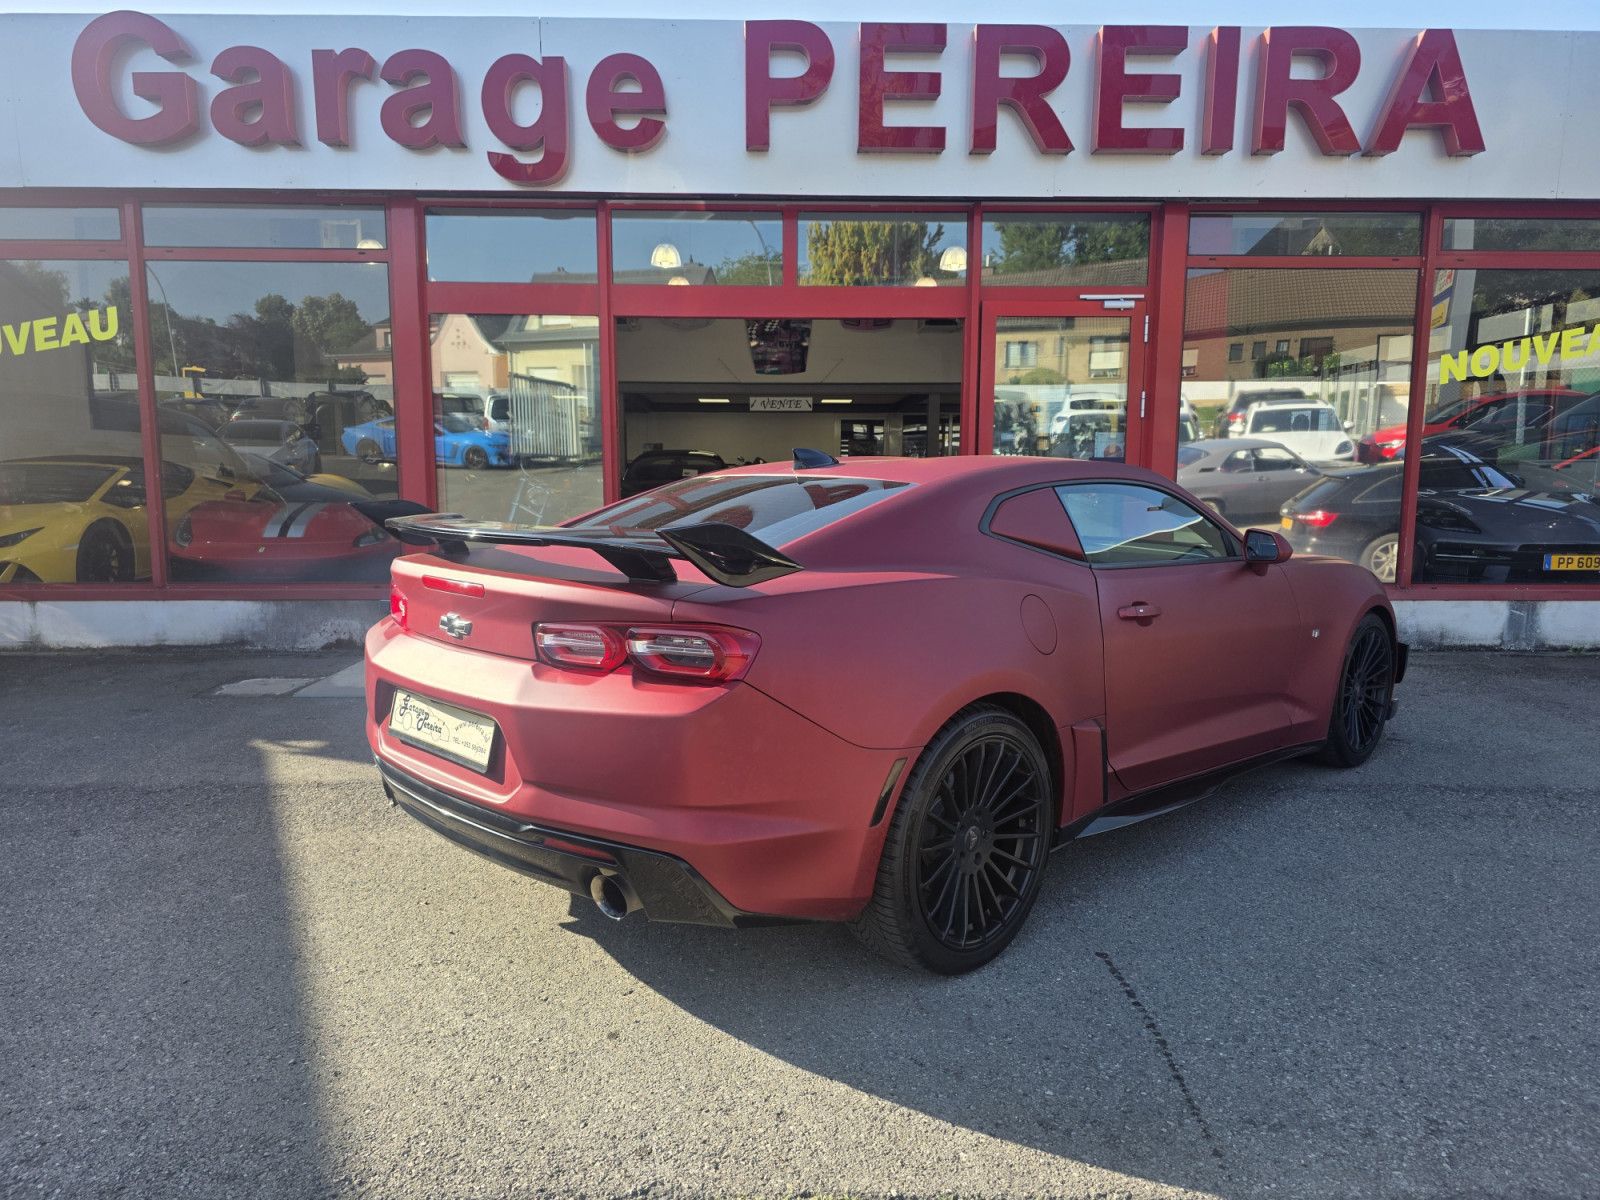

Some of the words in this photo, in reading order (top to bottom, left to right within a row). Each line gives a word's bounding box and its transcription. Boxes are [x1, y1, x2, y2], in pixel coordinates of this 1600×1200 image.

[71, 10, 668, 187] Garage
[745, 20, 1486, 157] PEREIRA
[0, 306, 119, 356] VEAU
[760, 398, 802, 409] VENTE
